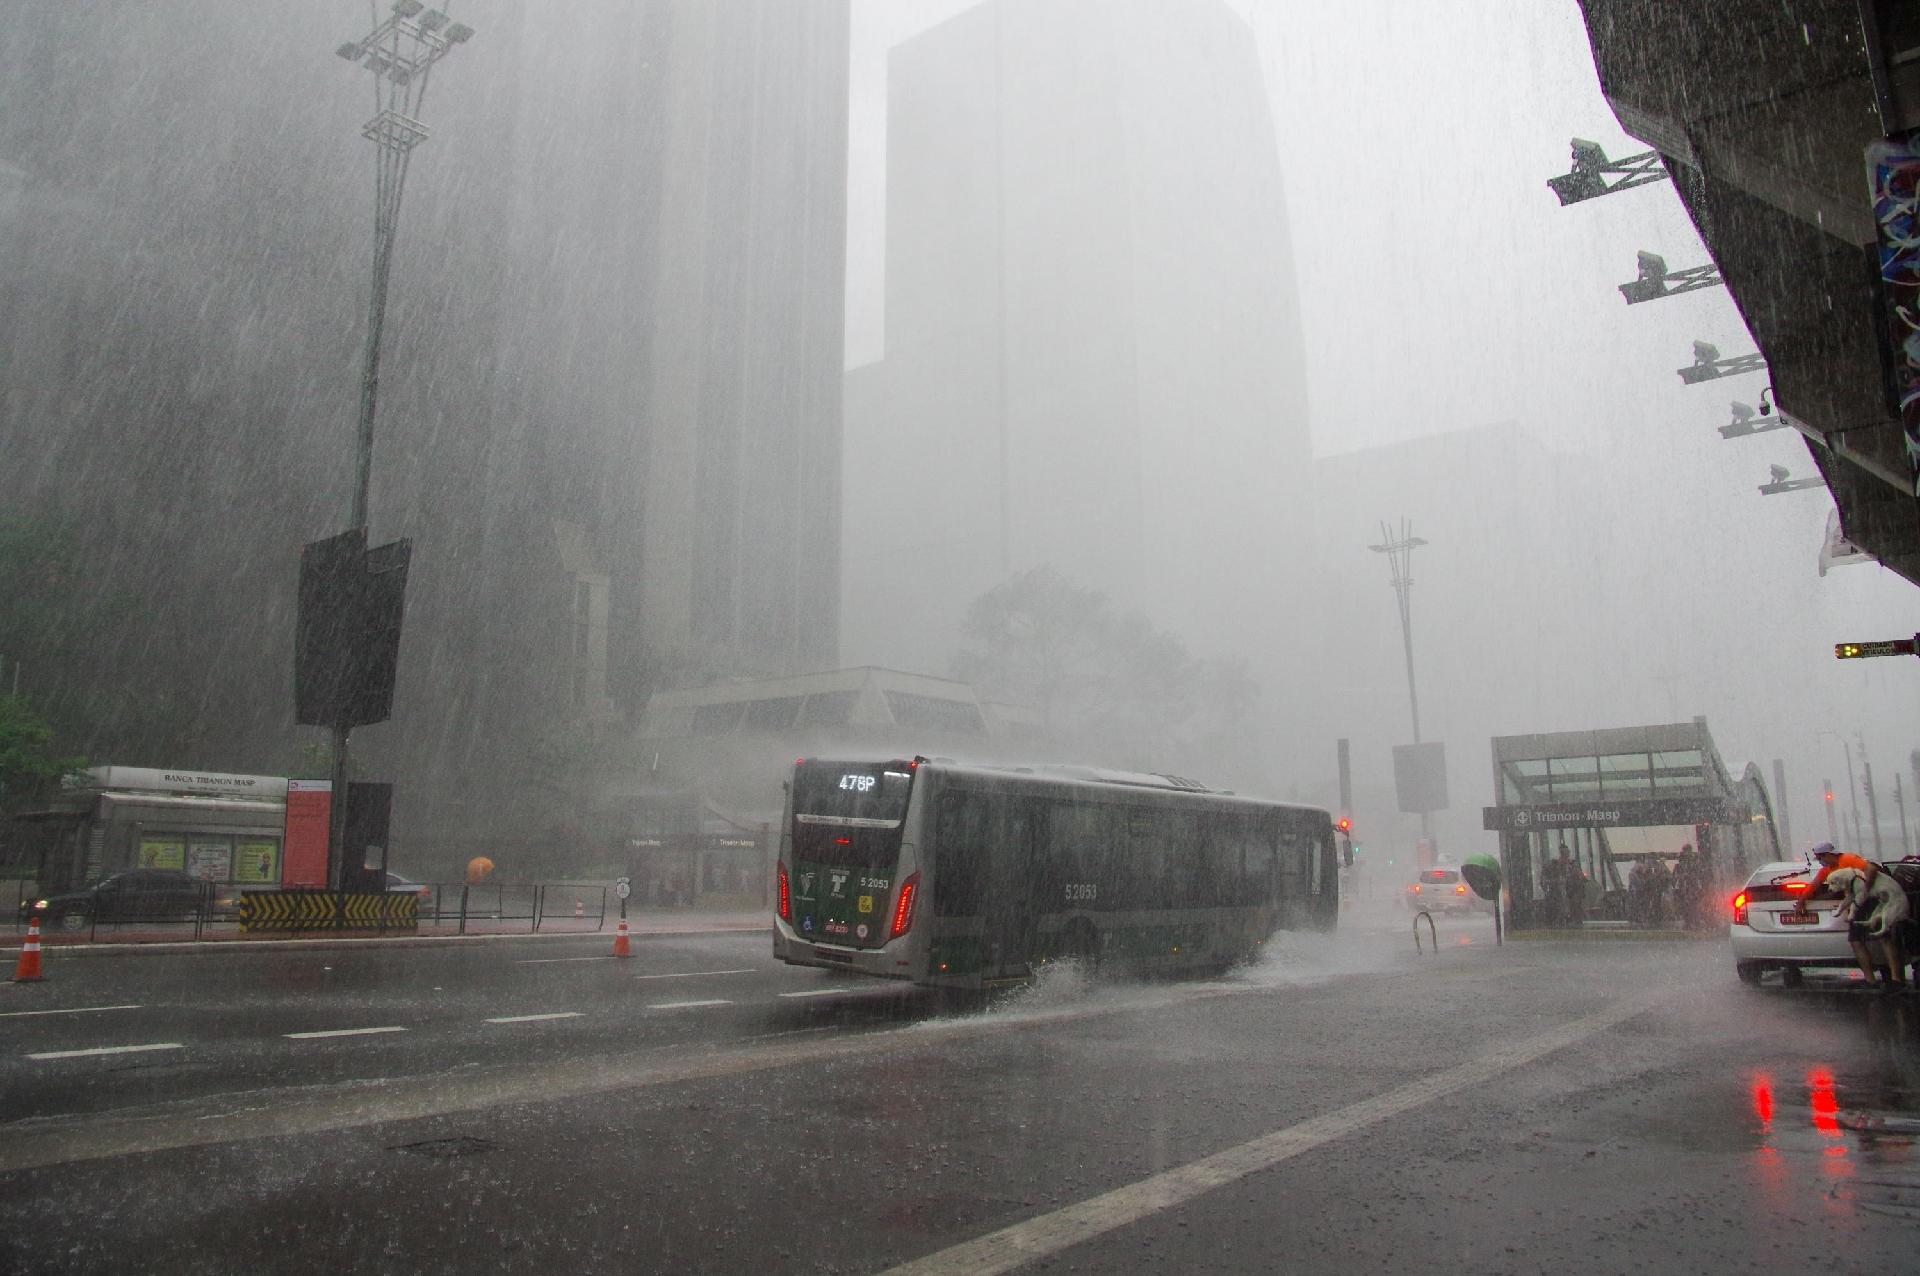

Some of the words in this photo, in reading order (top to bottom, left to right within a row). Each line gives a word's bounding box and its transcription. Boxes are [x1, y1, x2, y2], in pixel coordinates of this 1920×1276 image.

[839, 774, 875, 792] 478P
[1536, 811, 1580, 822] Trianon
[1586, 809, 1620, 822] Masp
